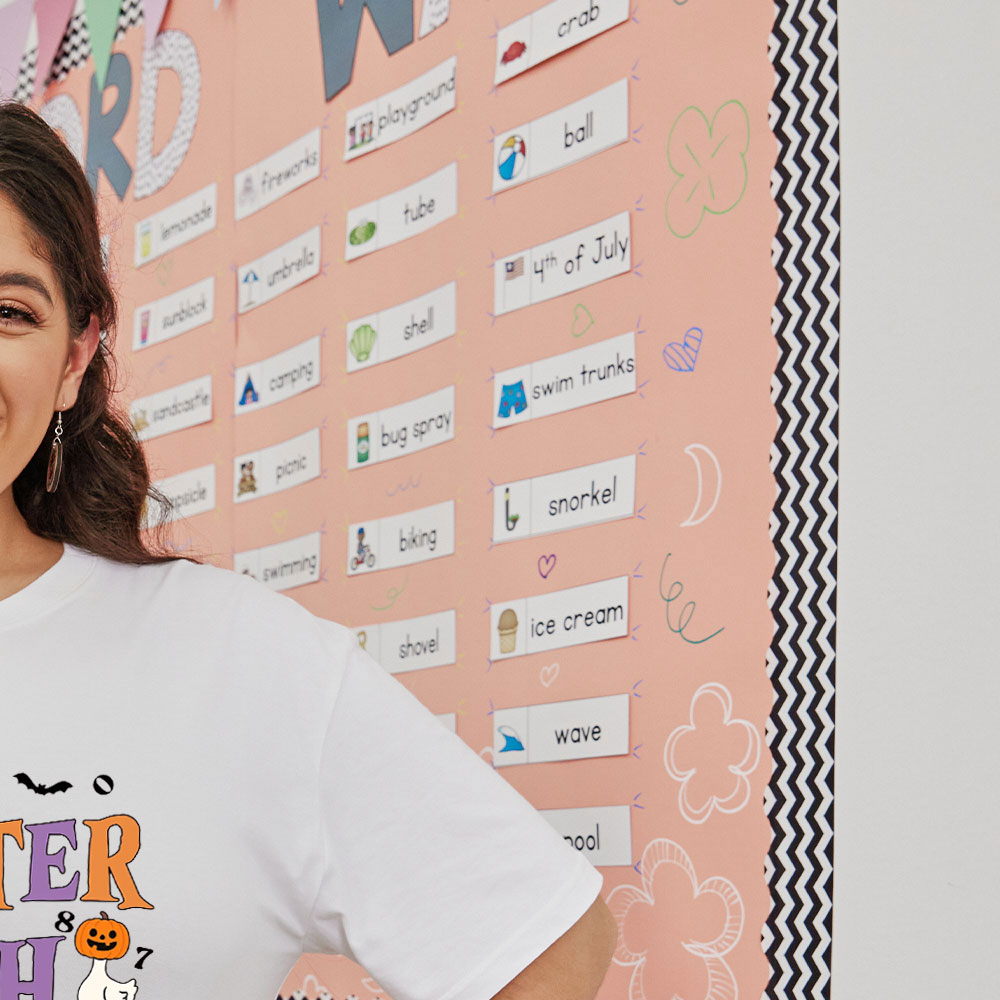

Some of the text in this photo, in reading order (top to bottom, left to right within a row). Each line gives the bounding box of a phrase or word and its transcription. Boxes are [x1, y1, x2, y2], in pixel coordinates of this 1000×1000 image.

[558, 0, 600, 38] crab
[378, 65, 457, 136] playground
[564, 110, 593, 148] ball
[261, 147, 318, 194] fireworks
[160, 199, 212, 242] lemonade
[404, 194, 435, 225] tube
[267, 246, 315, 288] umbrella
[564, 243, 585, 274] of
[592, 230, 629, 264] July
[404, 306, 434, 341] shell
[269, 360, 314, 392] camping
[532, 352, 635, 400] swim trunks
[381, 410, 452, 448] bug spray
[275, 455, 307, 484] picnic
[549, 475, 617, 516] snorkel
[399, 525, 437, 552] biking
[263, 554, 317, 582] swimming
[531, 604, 623, 638] ice cream
[399, 627, 440, 660] shovel
[555, 725, 602, 745] wave
[54, 911, 75, 933] 8
[134, 947, 154, 969] 7
